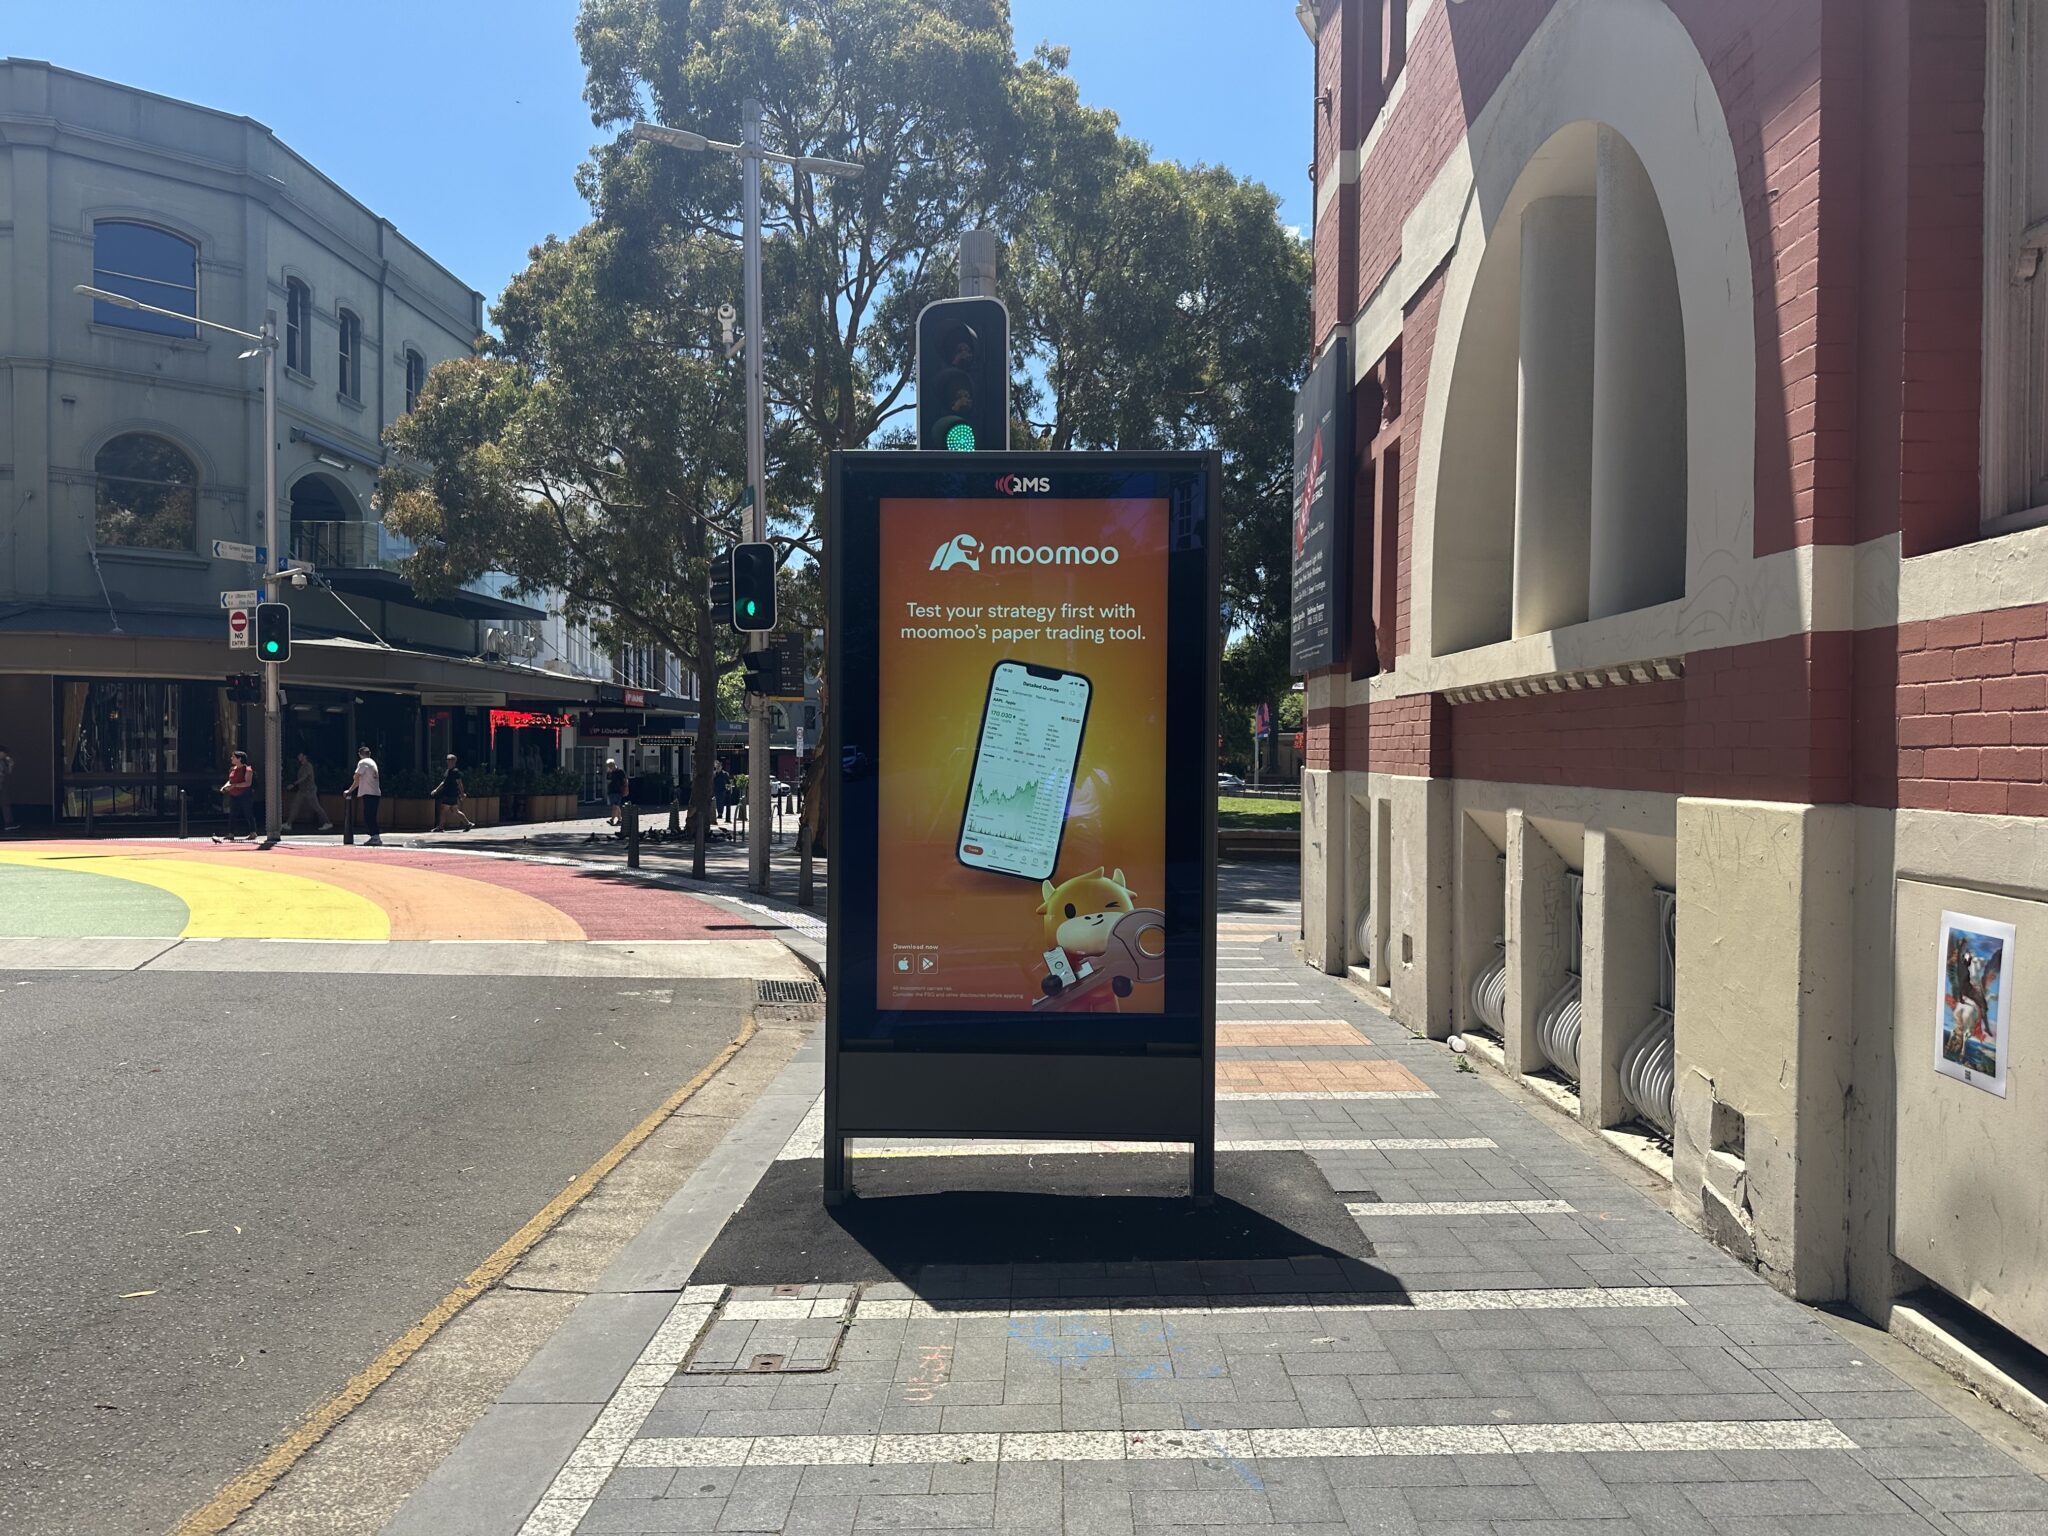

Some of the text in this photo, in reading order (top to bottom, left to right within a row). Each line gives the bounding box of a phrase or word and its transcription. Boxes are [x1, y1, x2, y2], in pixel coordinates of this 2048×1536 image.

[1004, 474, 1051, 496] QMS
[991, 545, 1120, 565] moomoo
[906, 602, 1136, 623] Test your strategy first with
[232, 638, 246, 646] ENTRY
[234, 632, 244, 640] NO
[901, 624, 1146, 644] moomoo's paper trading tool.
[1022, 681, 1060, 693] Detailed Quotes
